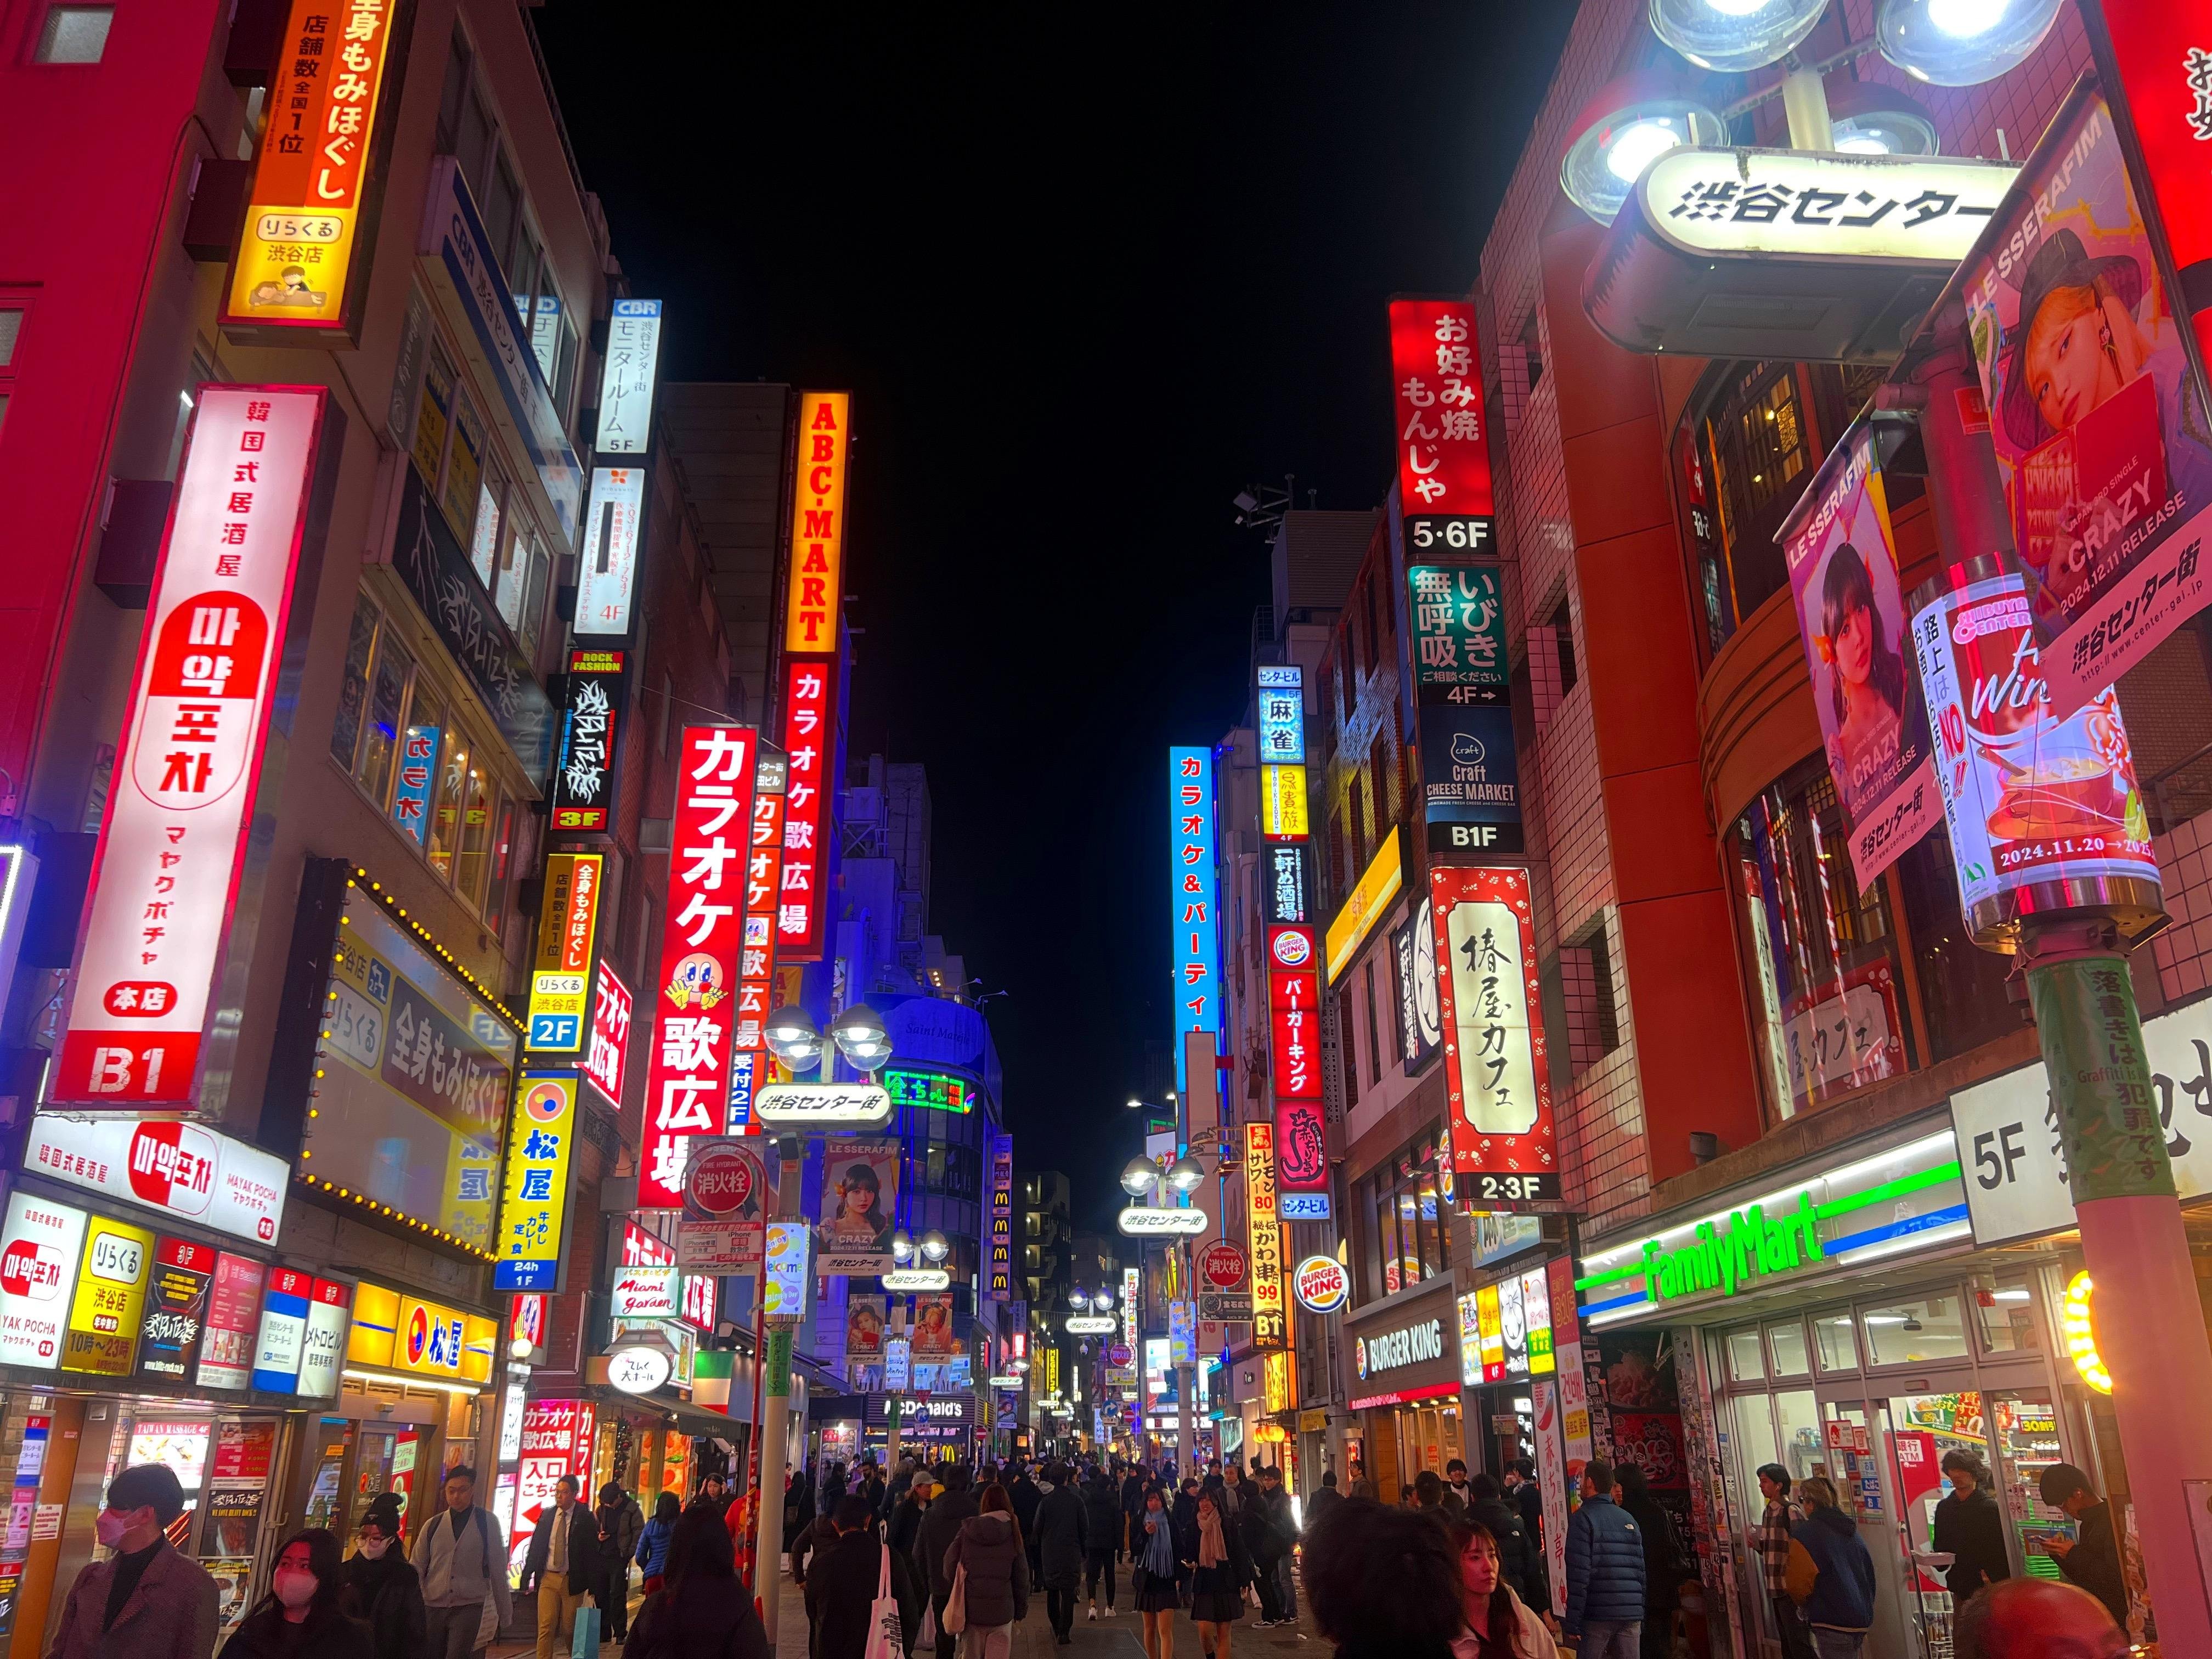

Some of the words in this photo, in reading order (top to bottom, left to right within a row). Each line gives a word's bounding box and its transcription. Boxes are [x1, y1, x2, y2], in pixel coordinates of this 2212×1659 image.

[279, 15, 328, 155] 店舗数全国1位
[1997, 112, 2102, 278] SSERAFIM
[264, 221, 333, 236] りらくる
[268, 245, 323, 264] 渋谷店
[618, 303, 657, 315] CBR
[634, 321, 653, 392] 渋谷センター街
[605, 320, 634, 432] モニタールーム
[1435, 315, 1479, 441] お好み焼
[610, 440, 633, 450] 5F
[1402, 377, 1446, 504] もんじゃ
[215, 401, 271, 576] 韓国式居酒屋
[1790, 539, 1806, 569] LE
[1807, 443, 1871, 547] SSERAFIM
[2068, 468, 2151, 572] CRAZY
[2061, 554, 2119, 616] 2024.12.11
[2121, 490, 2187, 555] RELEASE
[600, 605, 625, 620] 4F
[1415, 570, 1458, 668] 無呼吸
[1459, 571, 1498, 668] いびき
[1957, 597, 2028, 624] SHIBUYA
[2072, 538, 2201, 674] 渋谷センター街
[1952, 614, 2031, 644] CENTER
[574, 662, 620, 671] FASHION
[583, 653, 613, 662] ROCK
[1923, 613, 1949, 702] 路上は
[1260, 671, 1300, 682] センタービル
[1423, 672, 1502, 682] ご相談ください
[159, 607, 240, 792] 마약포차
[1447, 686, 1477, 704] 4F
[1270, 700, 1295, 751] 麻雀
[788, 674, 821, 808] カラオケ
[1455, 745, 1479, 754] craft
[1853, 723, 1900, 788] CRAZY
[1453, 765, 1486, 782] Craft
[1852, 778, 1882, 817] 2024.12.11
[1883, 745, 1917, 787] RELEASE
[1426, 783, 1463, 796] CHEESE
[1465, 783, 1514, 801] MARKET
[559, 812, 601, 827] 3F
[1860, 785, 1923, 864] 渋谷センター街
[675, 731, 745, 946] カラオケ
[1452, 826, 1497, 847] B1F
[748, 797, 776, 906] カラオケ
[778, 821, 814, 934] 歌広場
[1274, 849, 1297, 922] 一軒め酒場
[1181, 757, 1207, 1032] カラオケ&パーティ
[547, 874, 568, 957] 店舗数全国1位
[568, 865, 594, 966] 全身もみほぐし
[1279, 938, 1304, 949] BURGER
[1280, 945, 1306, 958] KING
[540, 979, 579, 991] りらくる
[114, 987, 167, 1011] 本店
[537, 998, 579, 1011] 渋谷店
[331, 998, 377, 1062] りらくる
[537, 1020, 573, 1041] 2F
[905, 1022, 935, 1036] Saint
[1460, 928, 1513, 1107] 椿屋カフェ
[1285, 979, 1305, 1092] バーガーキング
[88, 1047, 165, 1093] B1
[391, 1002, 502, 1133] 全身もみほぐし
[2078, 1069, 2123, 1083] Graffiti
[731, 1054, 752, 1122] 受付2F
[651, 1017, 722, 1193] 歌広場
[761, 1094, 884, 1110] 渋谷センター街
[39, 1144, 108, 1183] 韓国式居酒屋
[845, 1146, 897, 1154] SSERAFIM
[1974, 1122, 2026, 1190] 5F
[133, 1135, 213, 1194] 마약포차
[520, 1129, 559, 1200] 松屋
[1249, 1153, 1262, 1194] サワー
[1263, 1150, 1274, 1192] レモン
[227, 1173, 252, 1193] MAYAK
[255, 1182, 277, 1201] POCHA
[698, 1172, 747, 1195] 消火栓
[1255, 1196, 1273, 1209] 80
[1282, 1200, 1328, 1214] センタービル
[526, 1217, 537, 1249] カレー
[538, 1211, 549, 1245] 牛めし
[1125, 1215, 1205, 1226] 渋谷センター街
[1252, 1220, 1277, 1231] 秘伝
[511, 1224, 525, 1254] 定食
[838, 1234, 878, 1244] CRAZY
[1642, 1190, 1823, 1302] FamilyMart
[97, 1242, 137, 1274] りらくる
[177, 1246, 194, 1265] 3F
[514, 1263, 539, 1272] 24h
[766, 1261, 803, 1272] elcome
[828, 1259, 883, 1267] 渋谷センター街
[1209, 1258, 1241, 1274] 消火栓
[1255, 1233, 1277, 1282] かわ串
[4, 1254, 60, 1287] 마약포차
[517, 1277, 533, 1286] 1F
[885, 1276, 945, 1285] 渋谷センター街
[1300, 1266, 1340, 1286] BURGER
[616, 1280, 665, 1292] Miami
[1257, 1285, 1277, 1300] 99
[1304, 1276, 1342, 1300] KING
[93, 1288, 127, 1312] 渋谷店
[24, 1319, 55, 1336] POCHA
[1257, 1316, 1280, 1336] B1
[429, 1316, 464, 1367] 松屋
[1370, 1328, 1412, 1373] BURGER
[1410, 1318, 1442, 1363] KING
[138, 1424, 163, 1434] TAIWAN
[166, 1424, 197, 1434] MASSAGE
[199, 1425, 209, 1434] 4F
[524, 1408, 575, 1427] カラオケ
[523, 1430, 572, 1450] 歌広場
[1898, 1440, 1918, 1452] 銀行
[526, 1461, 562, 1480] 入口
[1899, 1452, 1920, 1462] ATM
